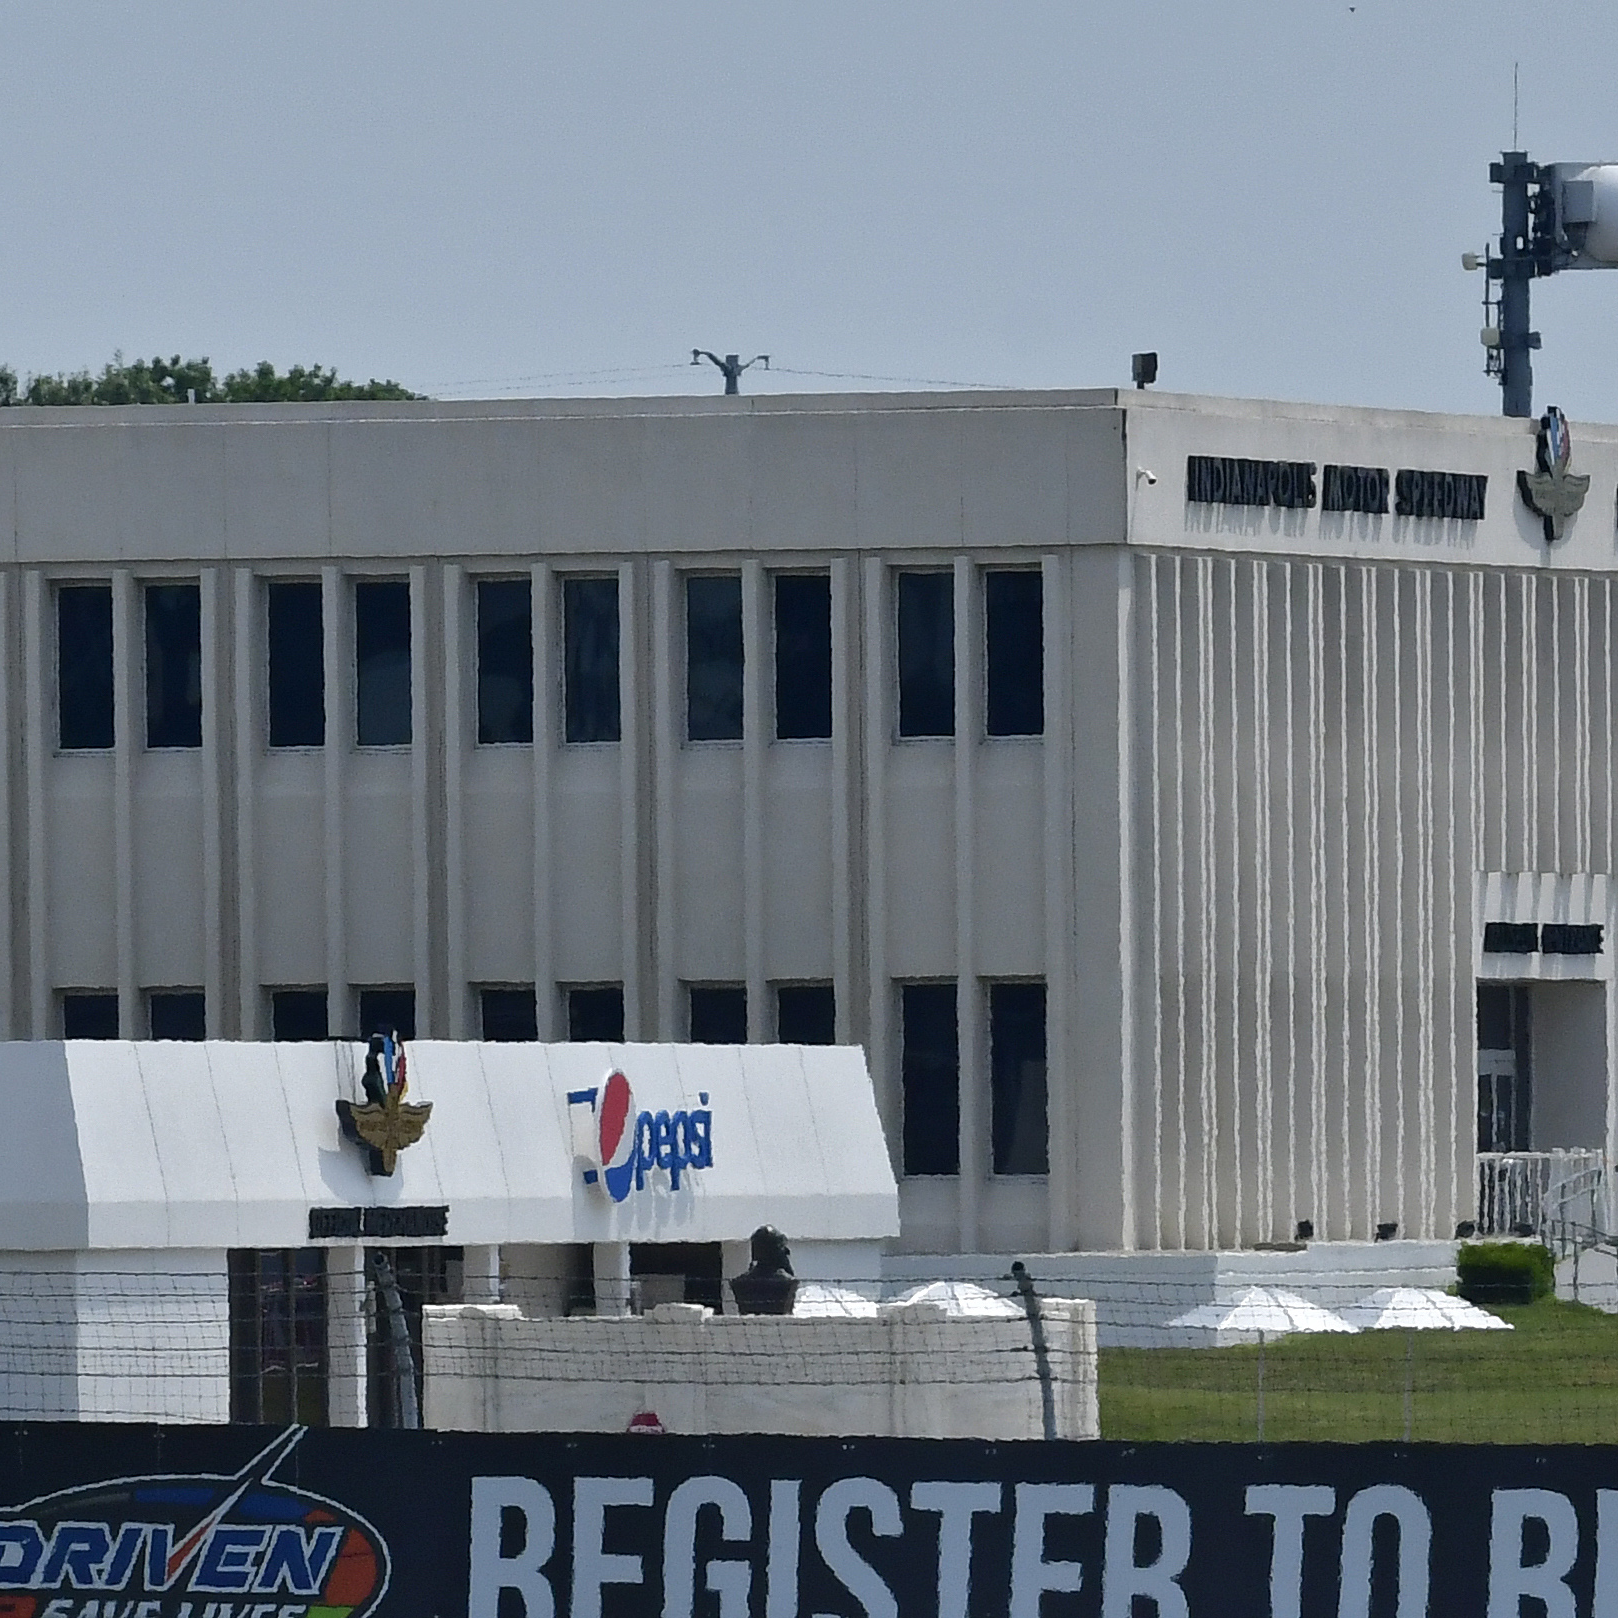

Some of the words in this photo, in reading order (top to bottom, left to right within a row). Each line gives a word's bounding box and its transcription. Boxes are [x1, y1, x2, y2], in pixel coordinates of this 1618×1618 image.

[1186, 455, 1317, 509] INDIANAPOLIS
[1321, 464, 1390, 514] MOTOR
[1394, 468, 1488, 520] SPEEDWAY
[635, 1092, 712, 1191] pepsi
